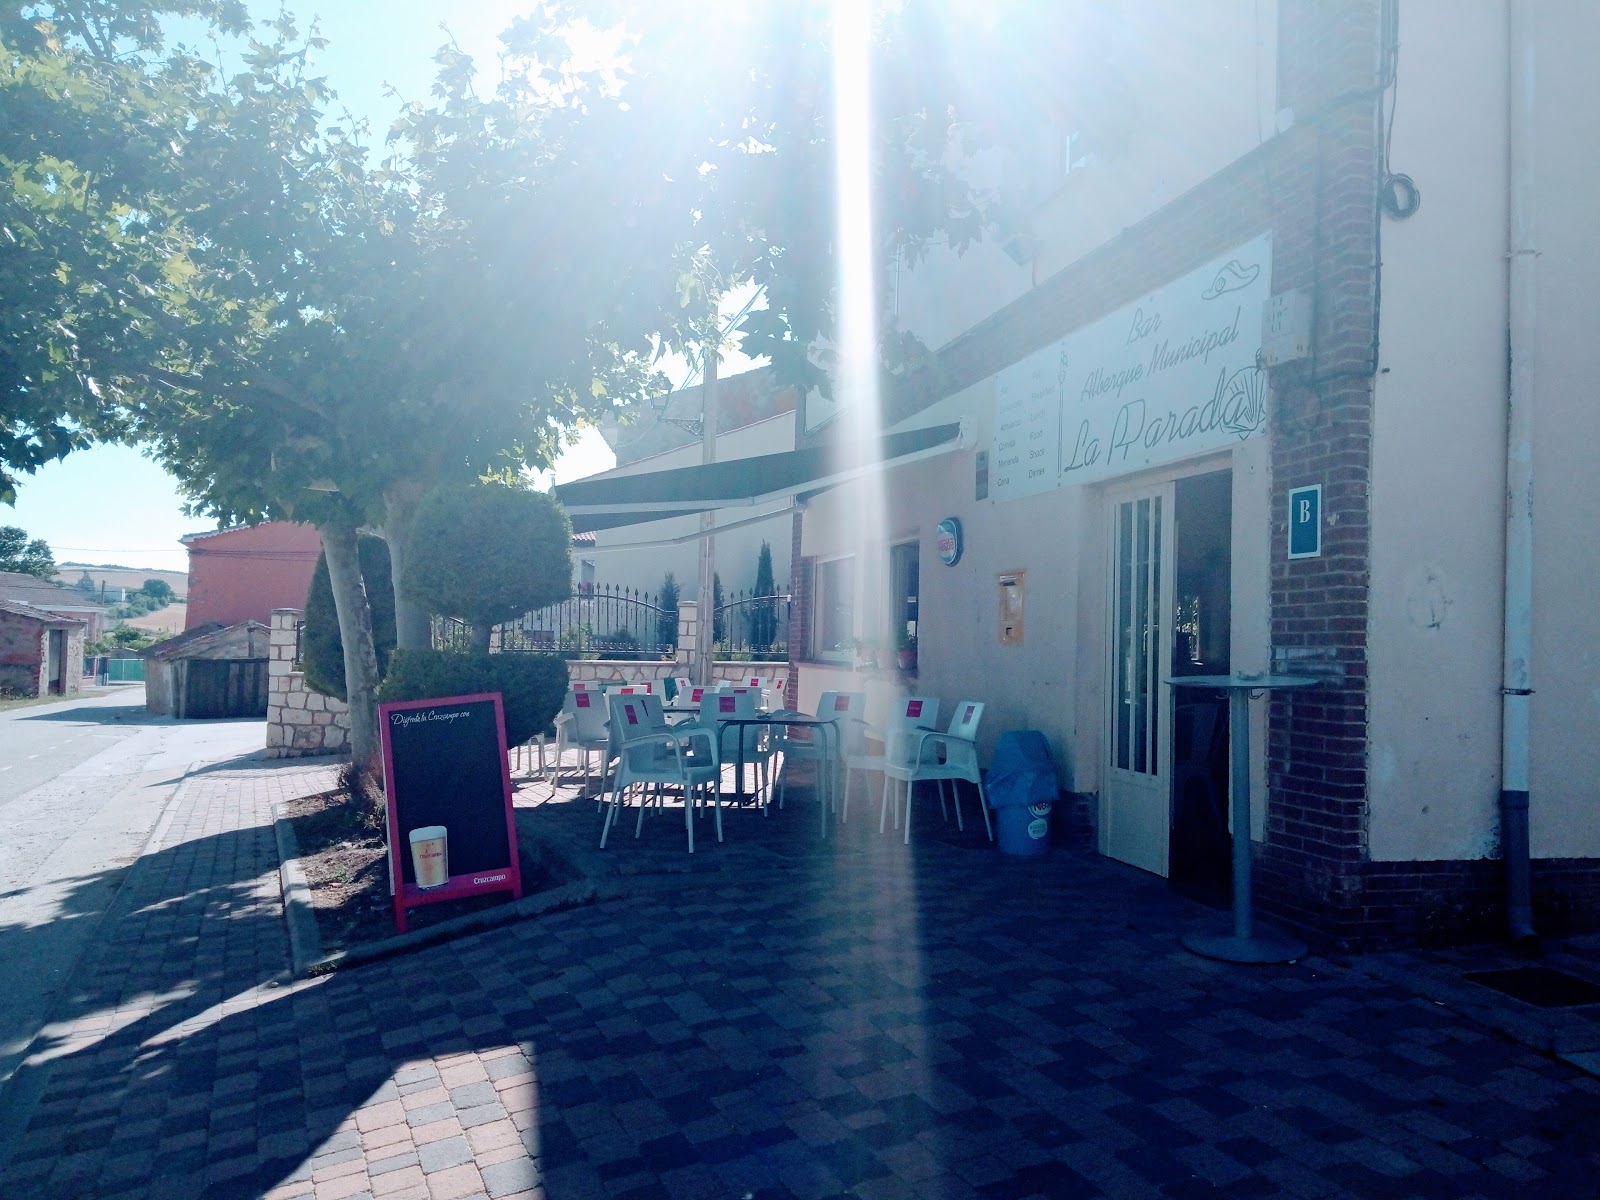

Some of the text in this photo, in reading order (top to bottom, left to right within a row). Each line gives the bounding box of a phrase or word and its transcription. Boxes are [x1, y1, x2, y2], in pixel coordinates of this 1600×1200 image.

[1126, 307, 1160, 345] Bar
[1147, 305, 1240, 377] Municipal
[1064, 366, 1246, 473] La Parada
[1029, 429, 1043, 441] Food
[1029, 448, 1046, 460] Snack
[1028, 467, 1046, 479] Dinner
[997, 477, 1010, 487] Cena
[1299, 499, 1311, 524] B
[473, 874, 507, 885] Cruzcampo
